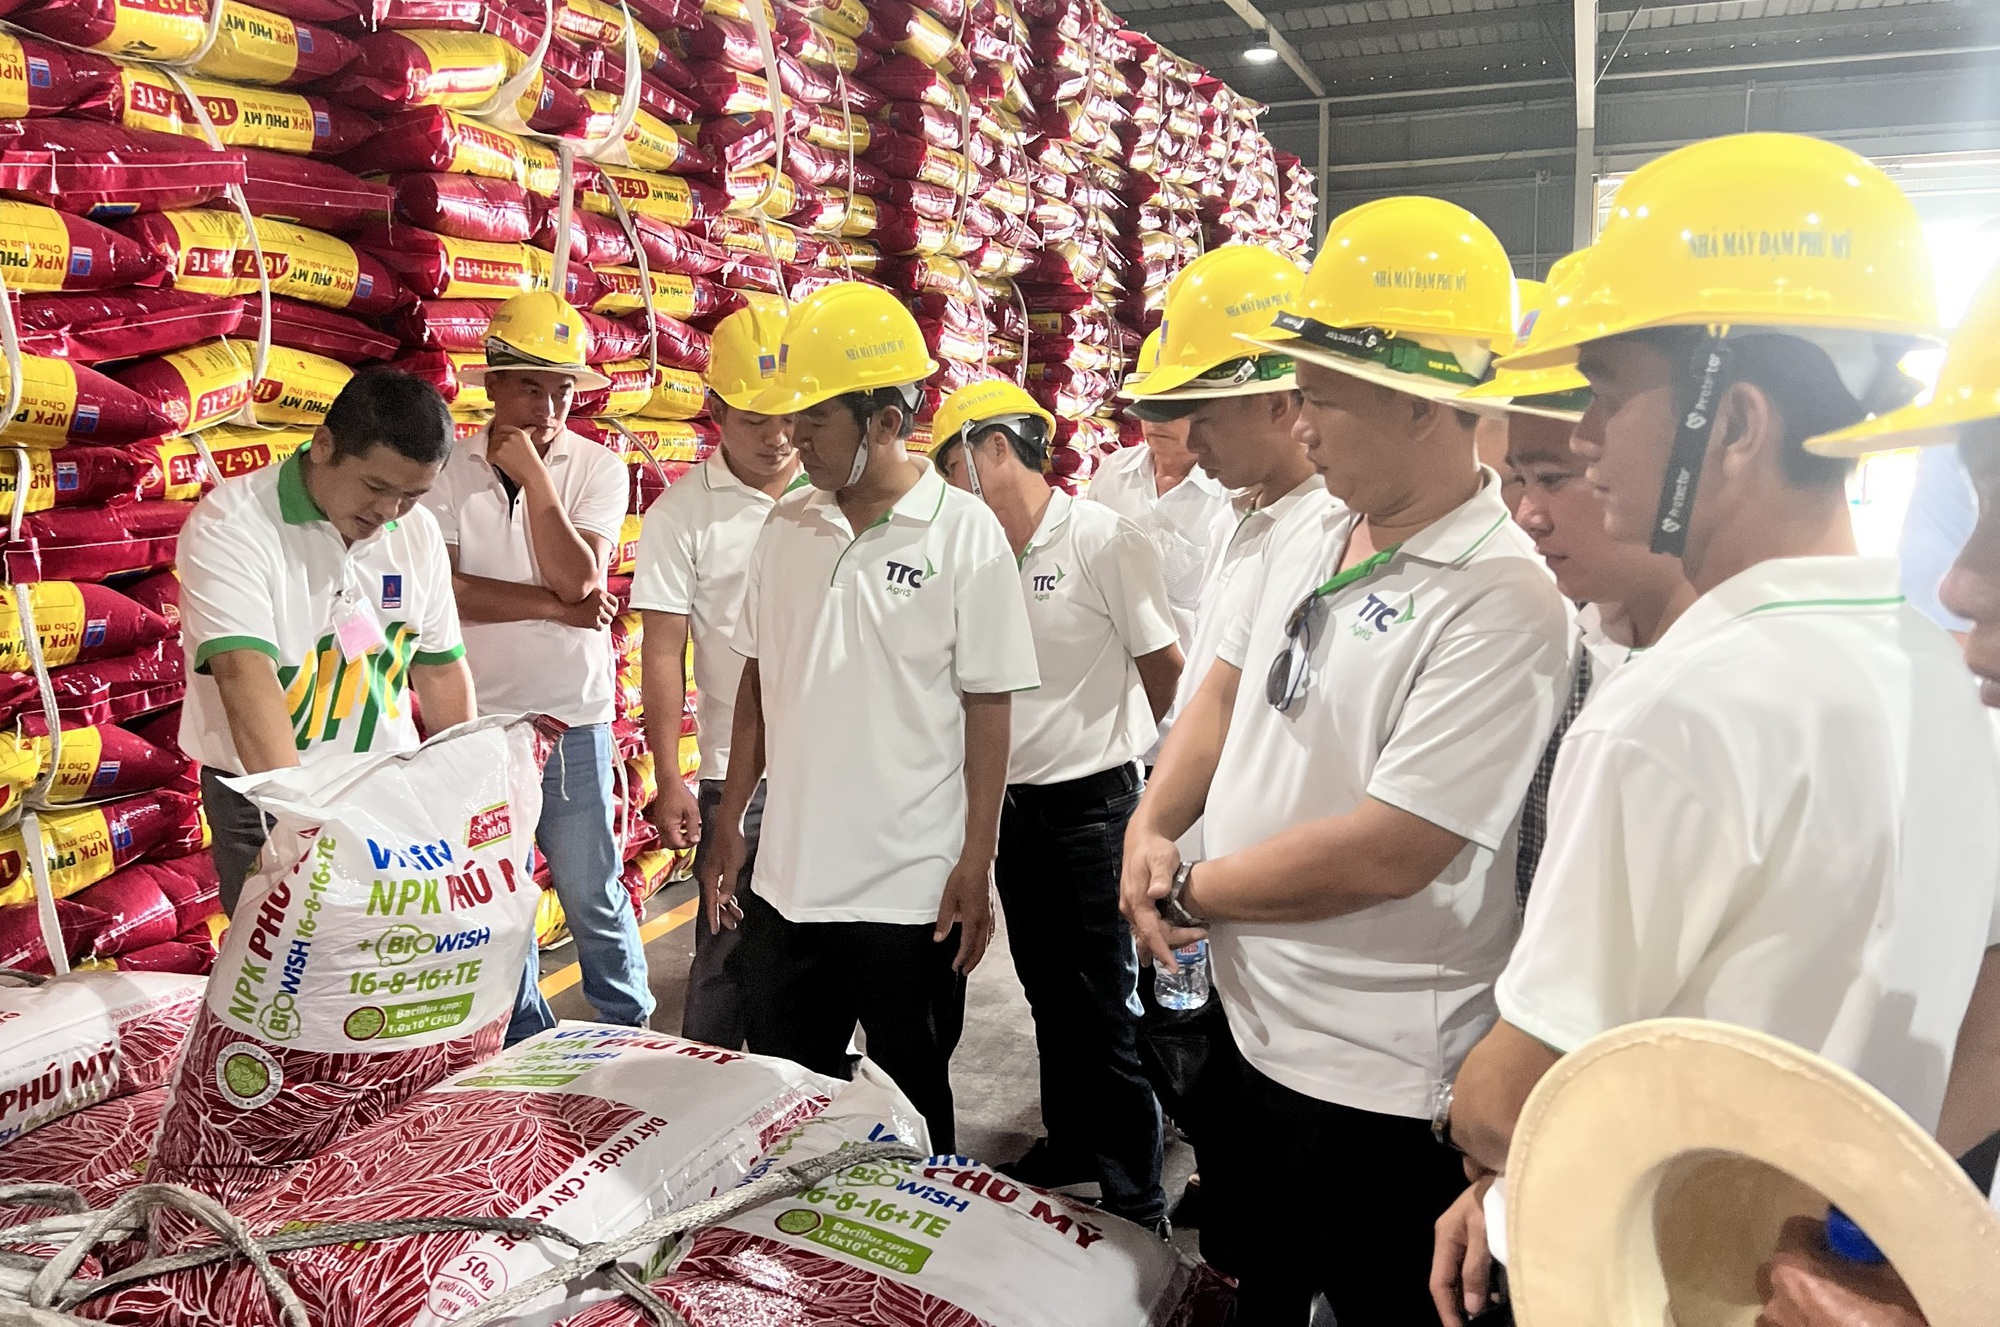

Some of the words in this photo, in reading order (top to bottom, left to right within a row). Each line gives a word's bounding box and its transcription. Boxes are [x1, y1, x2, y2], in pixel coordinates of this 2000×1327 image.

[250, 22, 272, 41] PHÚ
[274, 30, 294, 46] NPK
[0, 64, 22, 80] NP
[244, 112, 262, 128] MỸ
[266, 113, 290, 130] PHÚ
[292, 116, 312, 132] NPK
[40, 243, 62, 254] Cho
[33, 254, 65, 270] NPK
[289, 268, 308, 284] MỸ
[312, 271, 333, 288] PHÚ
[333, 274, 354, 292] NPK
[42, 400, 66, 411] Cho
[279, 396, 300, 410] MỸ
[301, 399, 331, 414] PHÚ
[32, 410, 68, 427] NPK
[0, 478, 17, 492] PH
[30, 474, 50, 489] NP
[886, 560, 924, 588] TTC
[1033, 576, 1056, 591] TTC
[1358, 593, 1399, 632] TTC
[54, 622, 76, 632] Cho
[48, 632, 79, 649] NPK
[68, 762, 90, 772] Cho
[58, 773, 91, 786] NPK
[80, 831, 102, 842] Cho
[79, 838, 108, 861] NPK
[296, 836, 336, 938] 16-8-16+TE
[366, 878, 442, 916] NPK
[349, 958, 482, 995] 16-8-16+TE
[228, 955, 272, 1024] NPK
[396, 1004, 434, 1020] Bacillus
[430, 1012, 460, 1026] CFU/g
[526, 1039, 599, 1050] NPK
[0, 1062, 60, 1120] PHÚ
[71, 1040, 116, 1089] MỸ
[633, 1116, 669, 1141] ĐẤT
[588, 1136, 640, 1174] KHỎE
[94, 1167, 138, 1192] NPK
[549, 1177, 586, 1206] CÂY
[1029, 1200, 1104, 1250] MỸ
[832, 1222, 884, 1246] Bacillus
[317, 1252, 350, 1272] thu
[868, 1248, 910, 1272] CFU/g
[458, 1256, 495, 1292] 50kg
